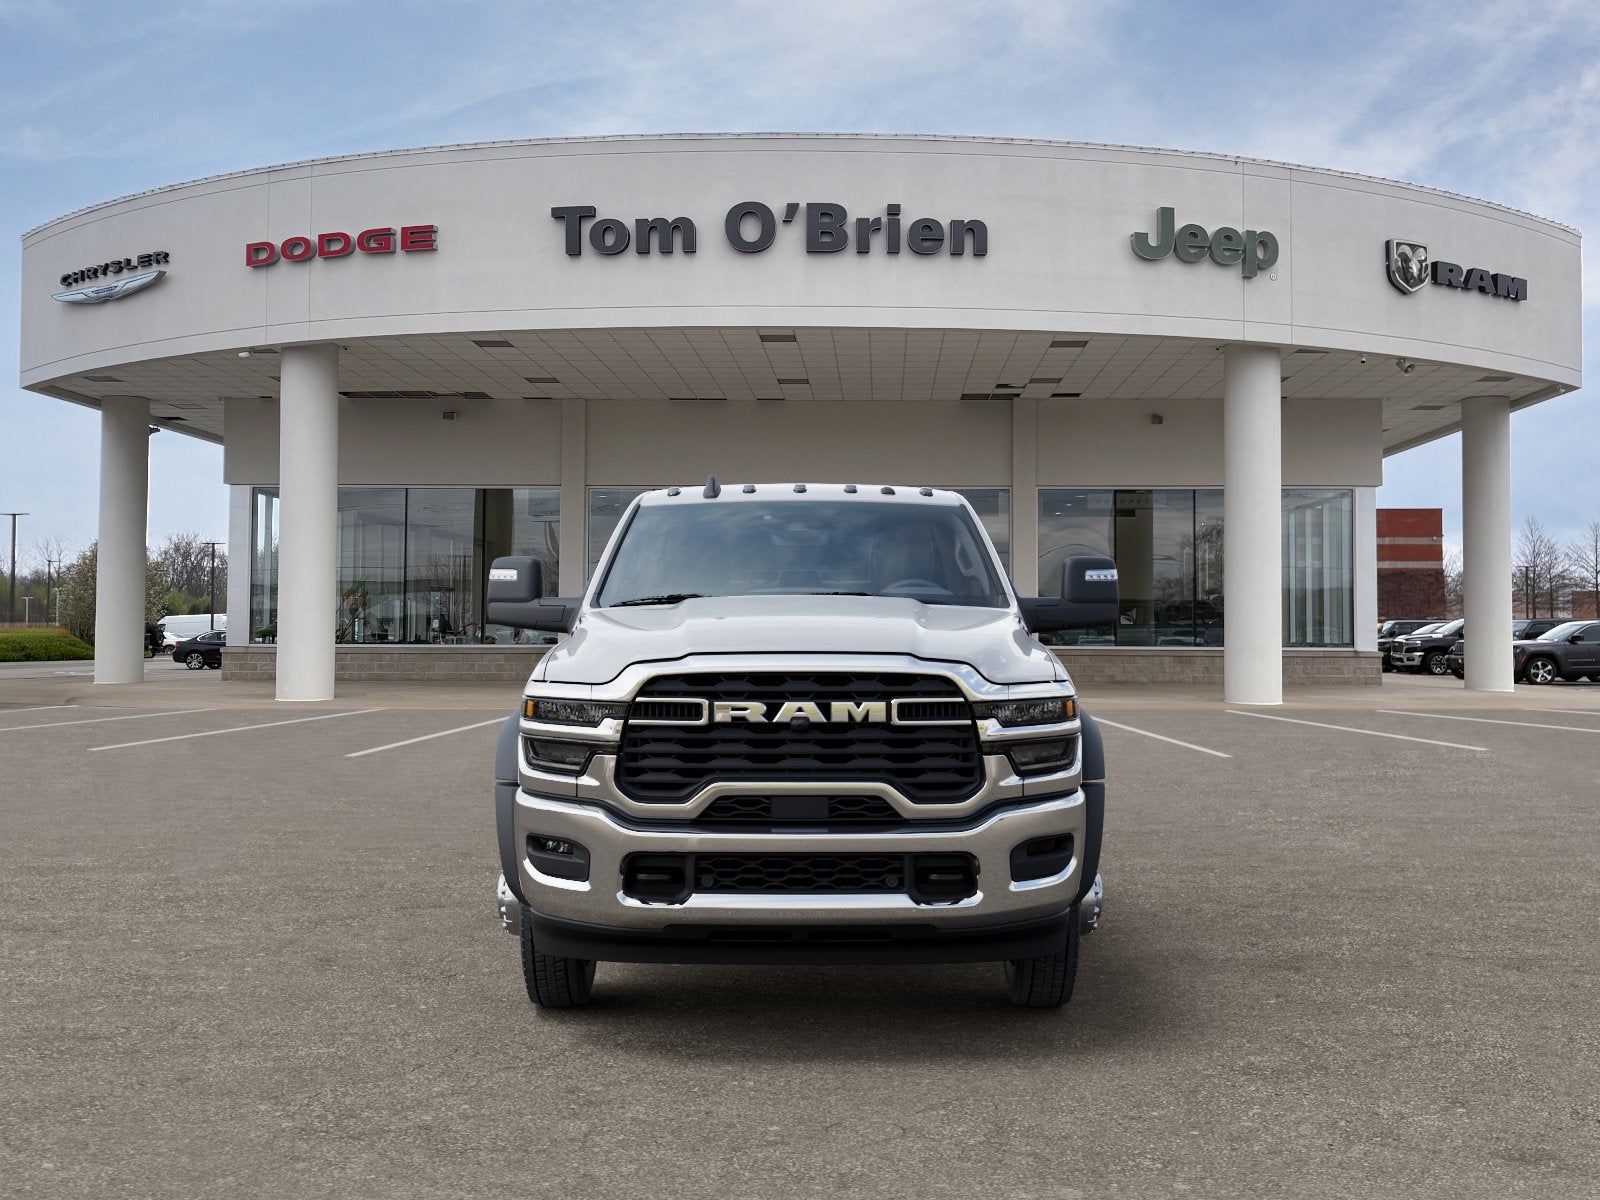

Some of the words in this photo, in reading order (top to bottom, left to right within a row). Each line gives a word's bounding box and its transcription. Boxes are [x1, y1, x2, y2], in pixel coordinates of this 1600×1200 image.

[245, 224, 439, 268] DODGE
[551, 205, 697, 256] Tom
[724, 201, 989, 256] O'Brien
[1130, 206, 1280, 278] Jeep
[59, 250, 171, 287] CHRYSLER
[1430, 260, 1528, 301] RAM
[712, 700, 888, 724] RAM
